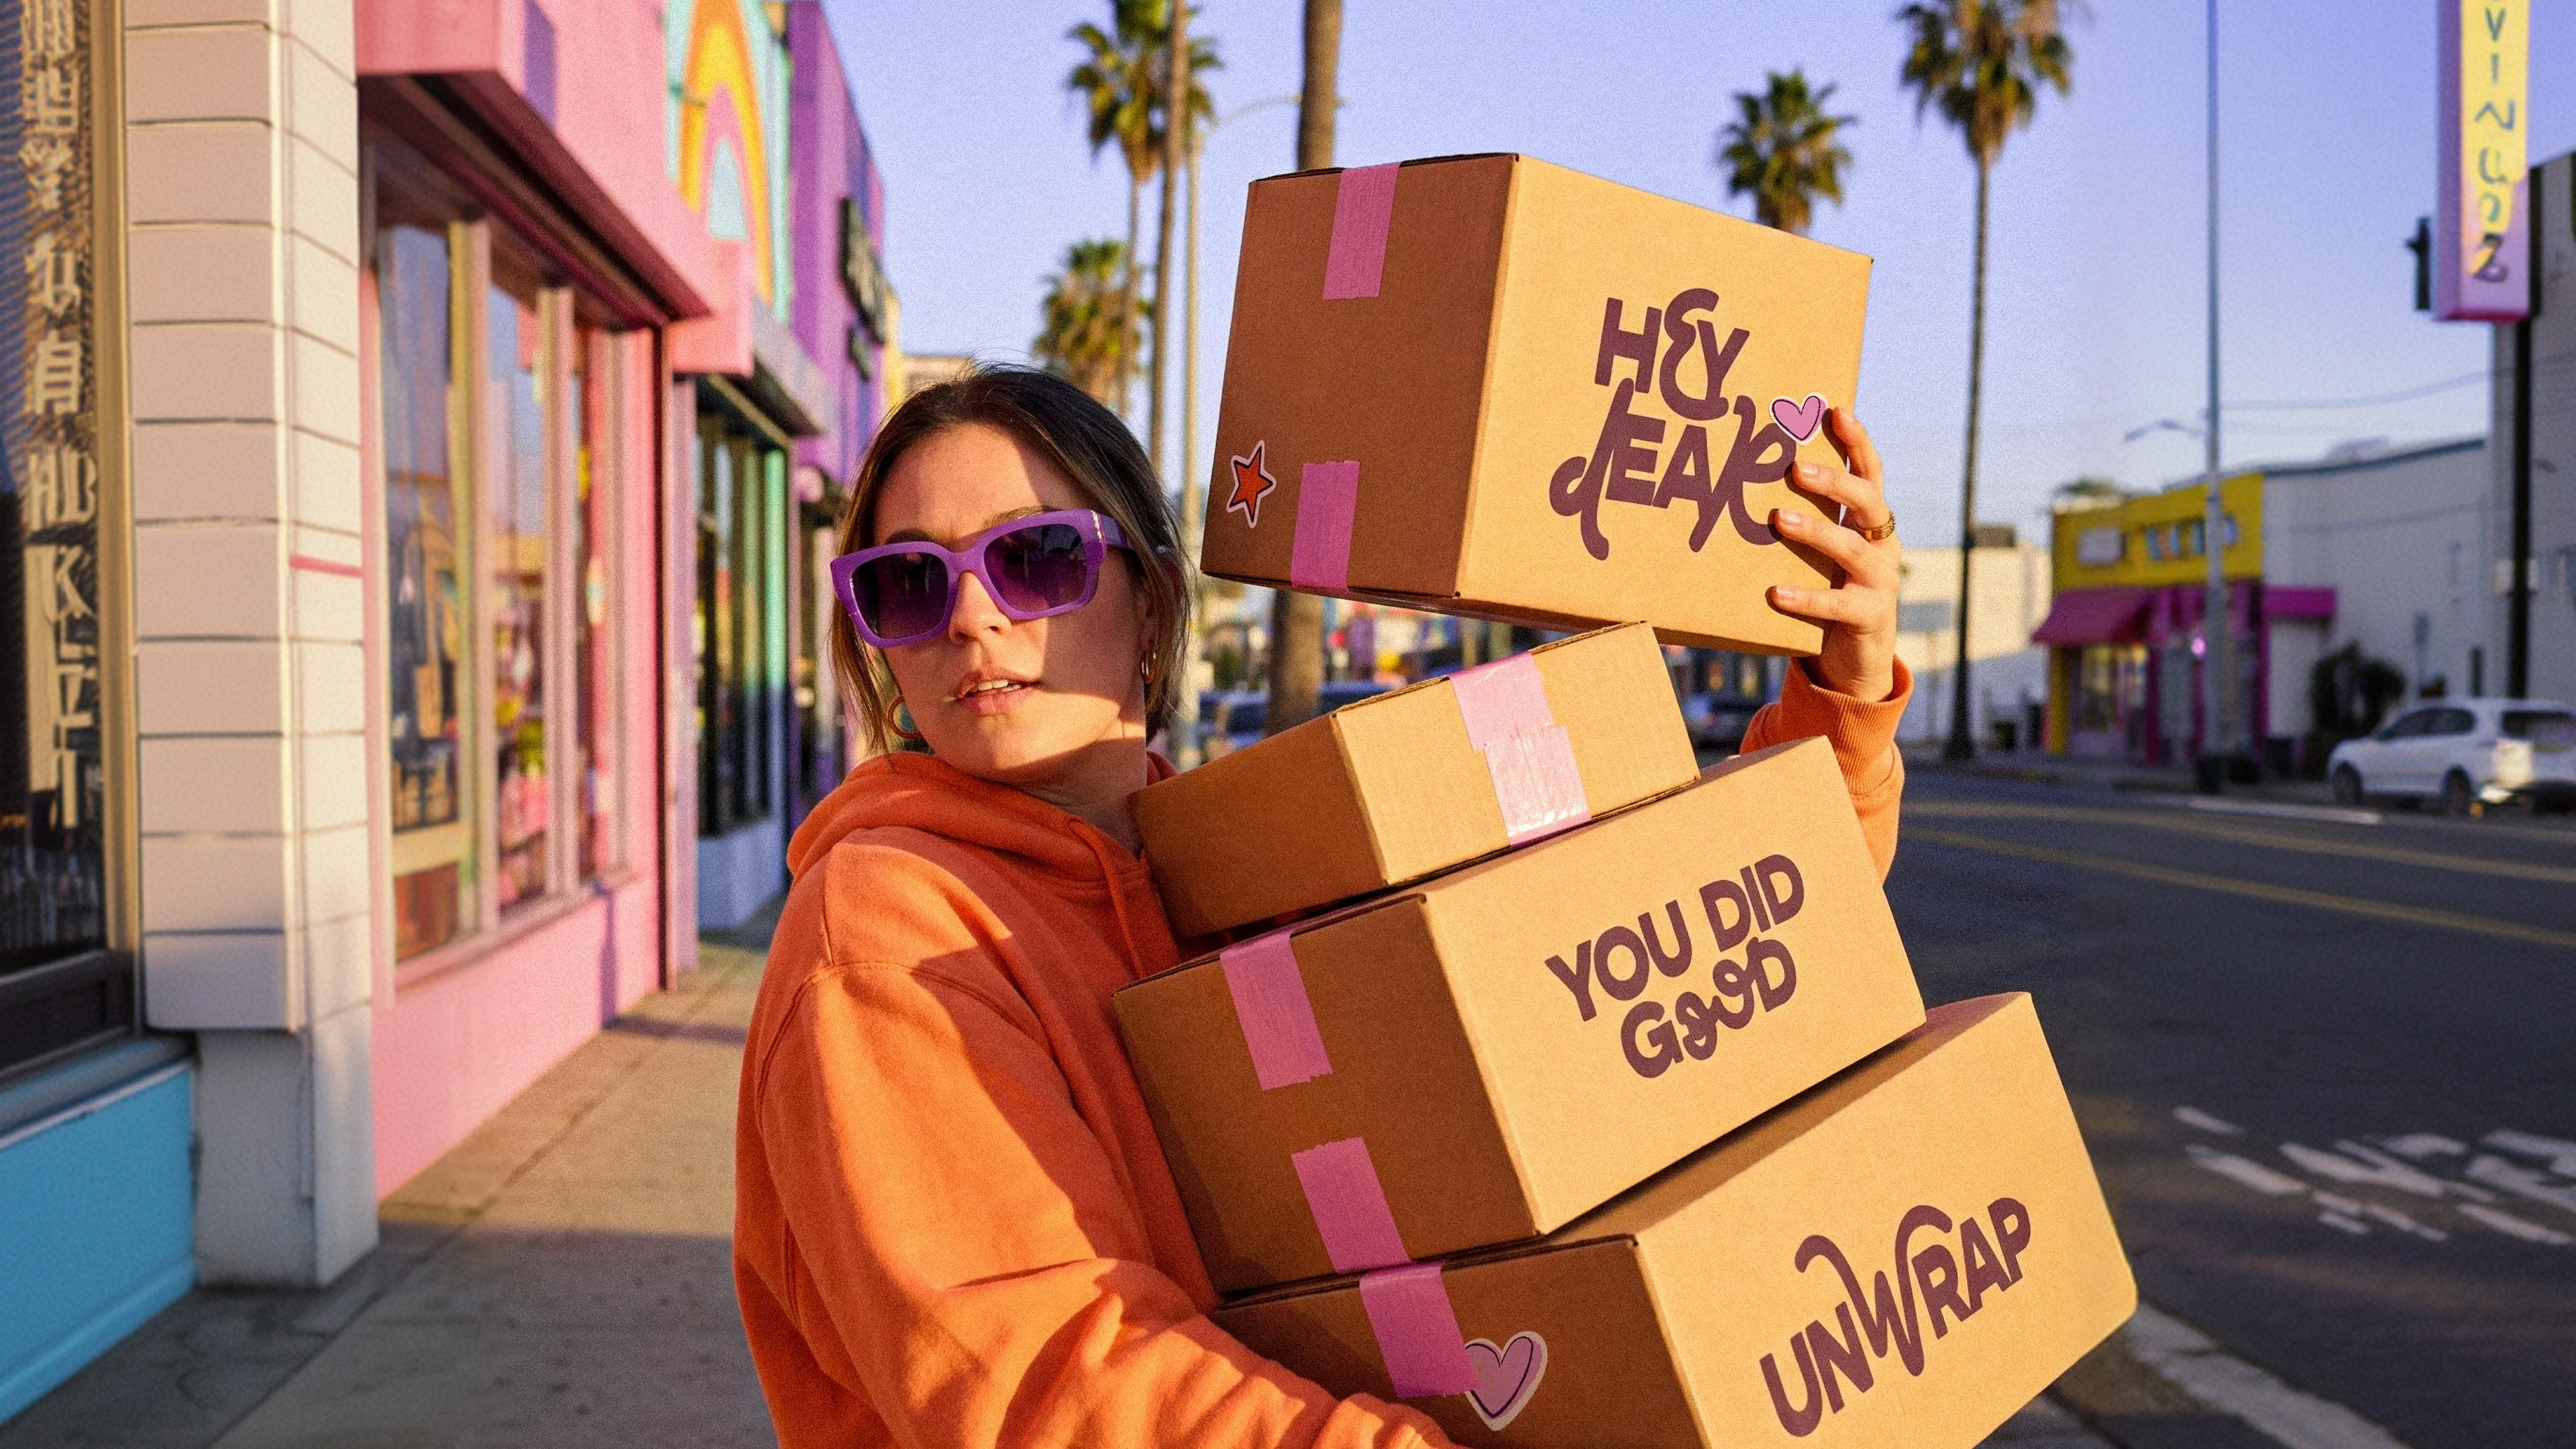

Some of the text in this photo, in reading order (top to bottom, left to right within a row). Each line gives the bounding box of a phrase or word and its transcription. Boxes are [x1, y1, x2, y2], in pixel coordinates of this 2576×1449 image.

[1594, 288, 1750, 421] HEY
[1544, 854, 1805, 1022] YOU DID
[1621, 936, 1796, 1079] GOOD
[1759, 1197, 2031, 1438] UNWRAP
